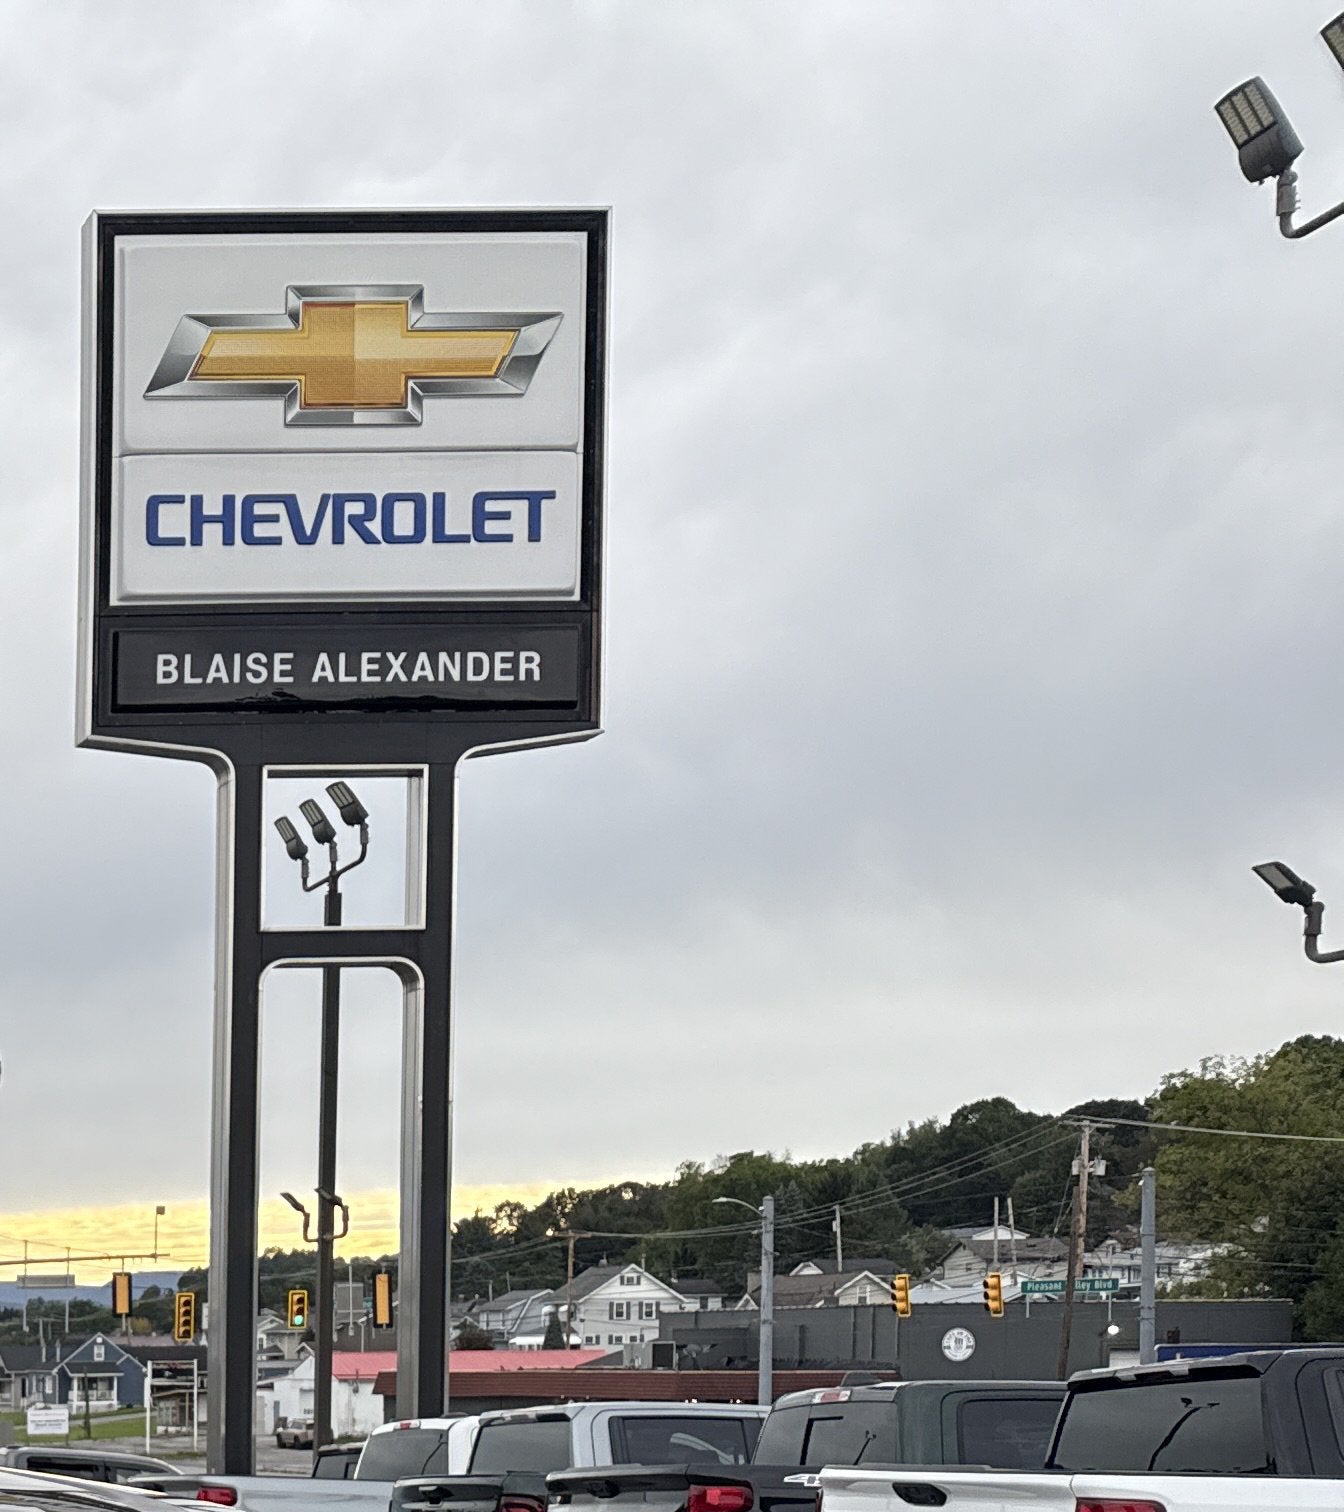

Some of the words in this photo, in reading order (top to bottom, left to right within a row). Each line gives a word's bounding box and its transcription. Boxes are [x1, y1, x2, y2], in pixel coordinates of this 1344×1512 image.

[145, 490, 557, 546] CHEVROLET
[155, 652, 295, 685] BLAISE
[311, 650, 543, 684] ALEXANDER
[1026, 1281, 1062, 1291] Pleasant
[1094, 1279, 1113, 1290] Blvd
